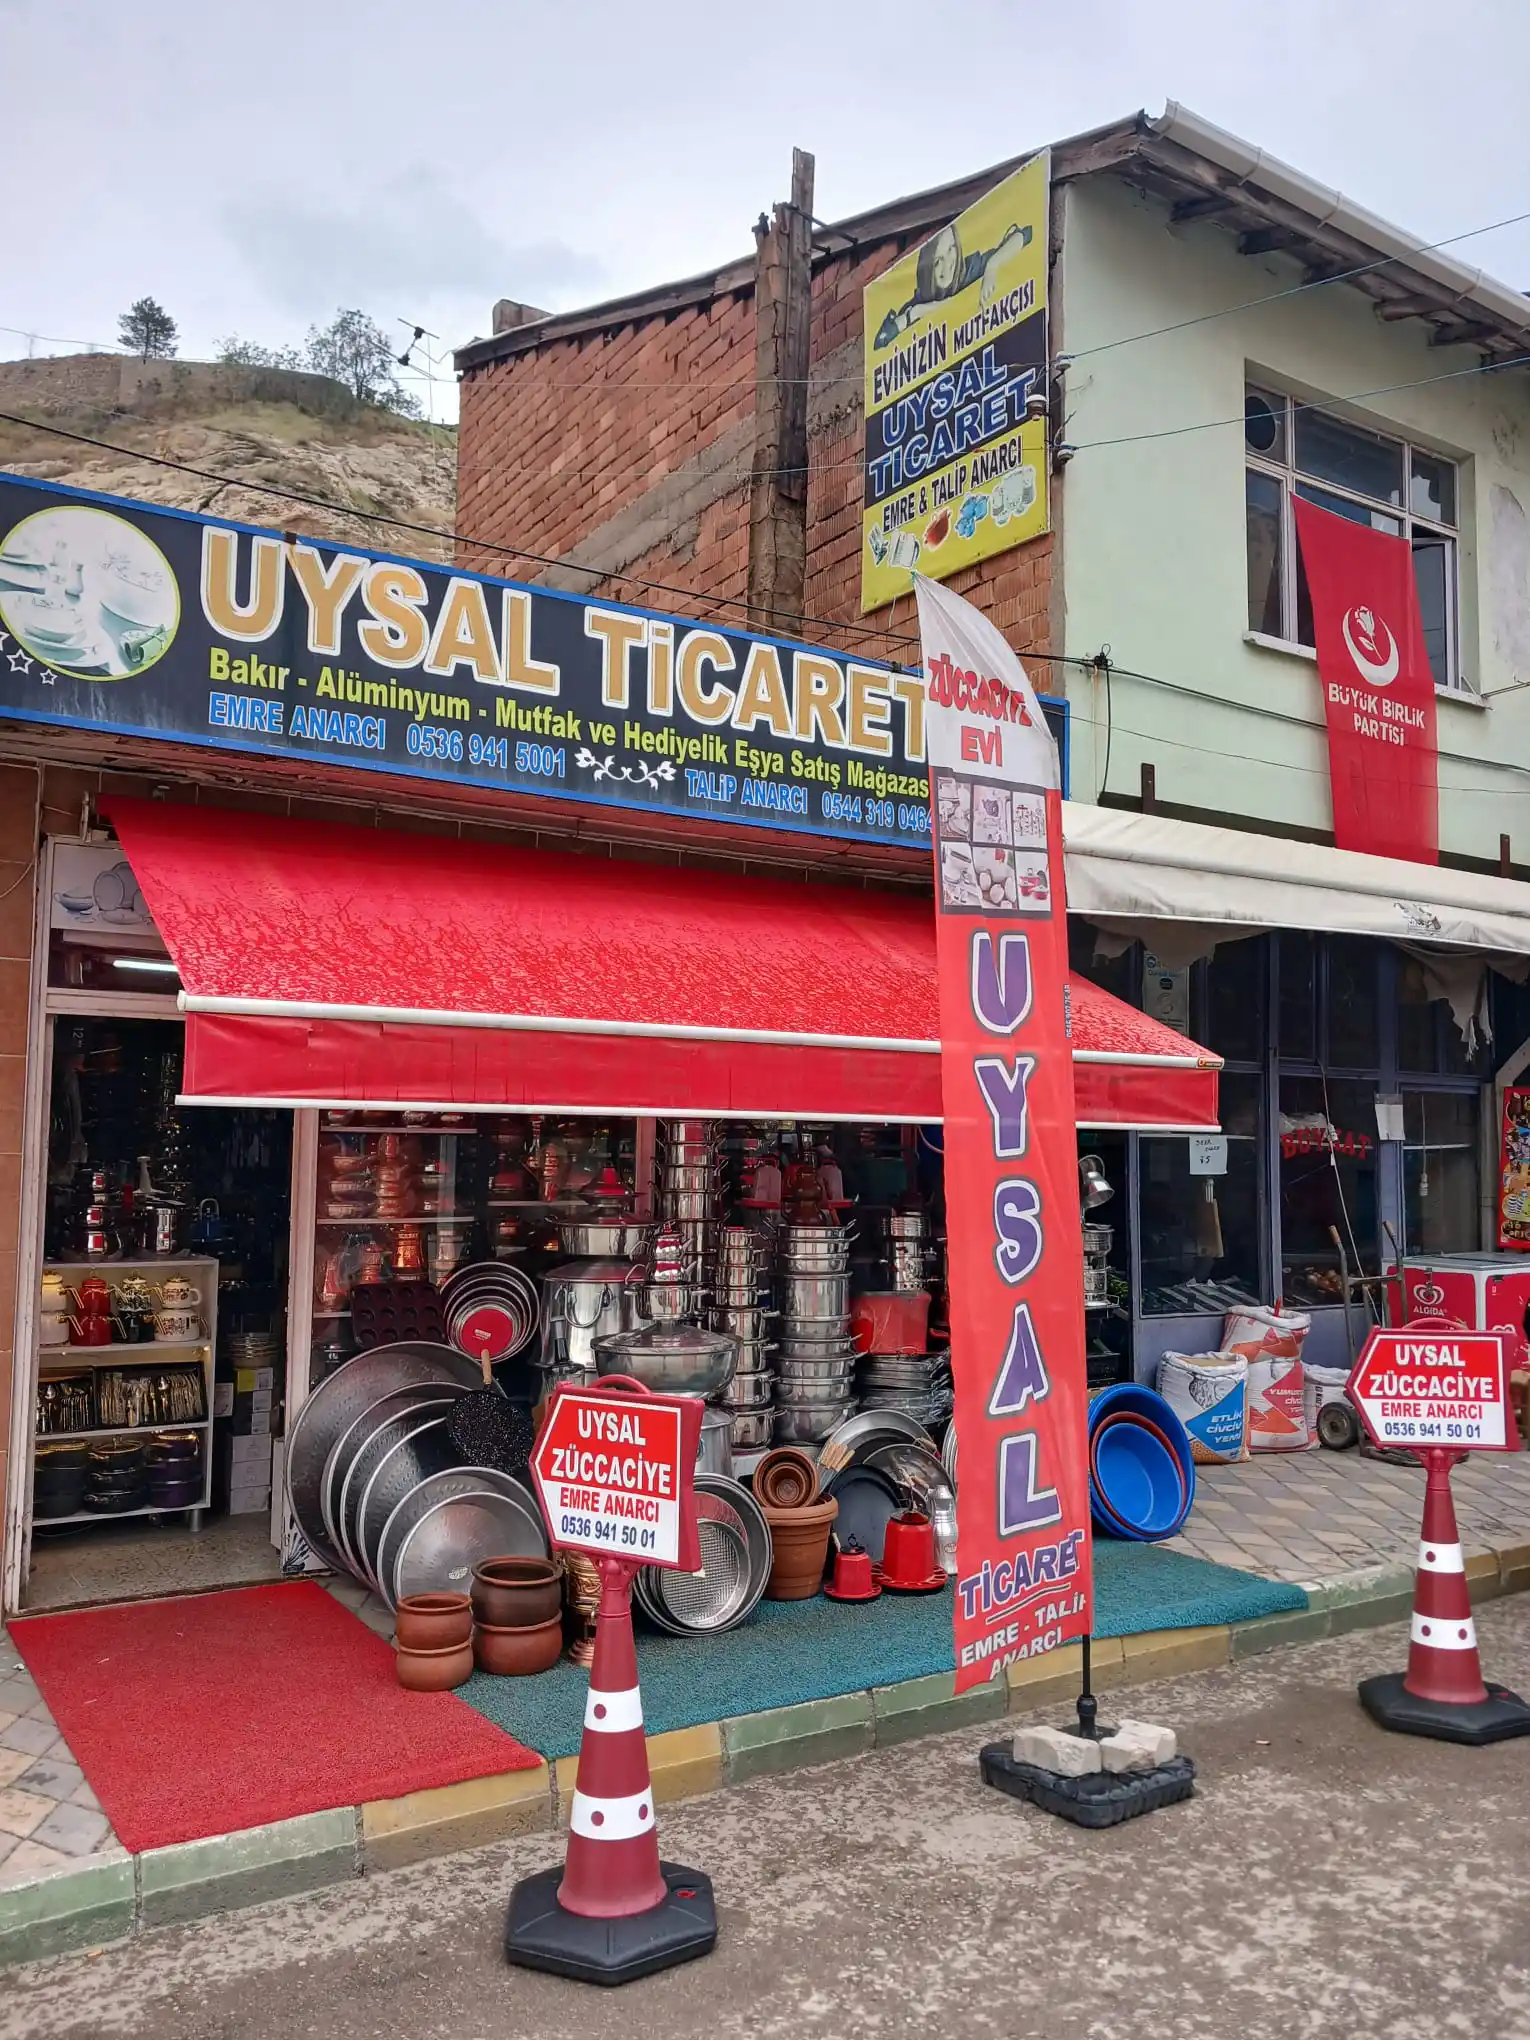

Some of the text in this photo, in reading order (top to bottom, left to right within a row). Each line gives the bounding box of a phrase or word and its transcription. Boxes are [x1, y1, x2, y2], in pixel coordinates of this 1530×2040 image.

[873, 279, 1035, 404] EVİNİZİN MUTFAKÇISI
[882, 344, 1008, 447] UYSAL
[883, 435, 1023, 534] EMRE & TALİP ANARCI
[200, 523, 561, 696] UYSAL
[209, 646, 291, 690] Bakır
[315, 666, 470, 722] Alüminyum
[495, 697, 582, 741] Mutfak
[588, 721, 617, 746] ve
[624, 720, 729, 765] Hediyelik
[735, 739, 785, 778] Eşya
[791, 749, 841, 790] Satış
[847, 759, 930, 799] Mağazas
[1328, 682, 1379, 715] BÜYÜK
[209, 691, 566, 778] EMRE ANARCI 0536 941 5001
[961, 724, 1003, 767] EVİ
[1353, 713, 1405, 746] PARTİSİ
[741, 777, 808, 815] ANARCI
[821, 791, 863, 824] 0544
[865, 798, 895, 828] 319
[970, 929, 1062, 1537] UYSAL
[1395, 1343, 1466, 1367] UYSAL
[1369, 1370, 1494, 1399] ZÜCCACİYE
[578, 1408, 646, 1446] UYSAL
[1381, 1401, 1483, 1420] EMRE ANARCI
[1384, 1422, 1481, 1439] 0536 941 50 01
[551, 1443, 671, 1495] ZÜCCACİYE
[560, 1486, 660, 1523] EMRE ANARCI
[561, 1514, 656, 1550] 0536 941 50 01
[958, 1528, 1086, 1621] TİCARET
[961, 1622, 1020, 1668] EMRE
[989, 1625, 1063, 1681] ANARCI
